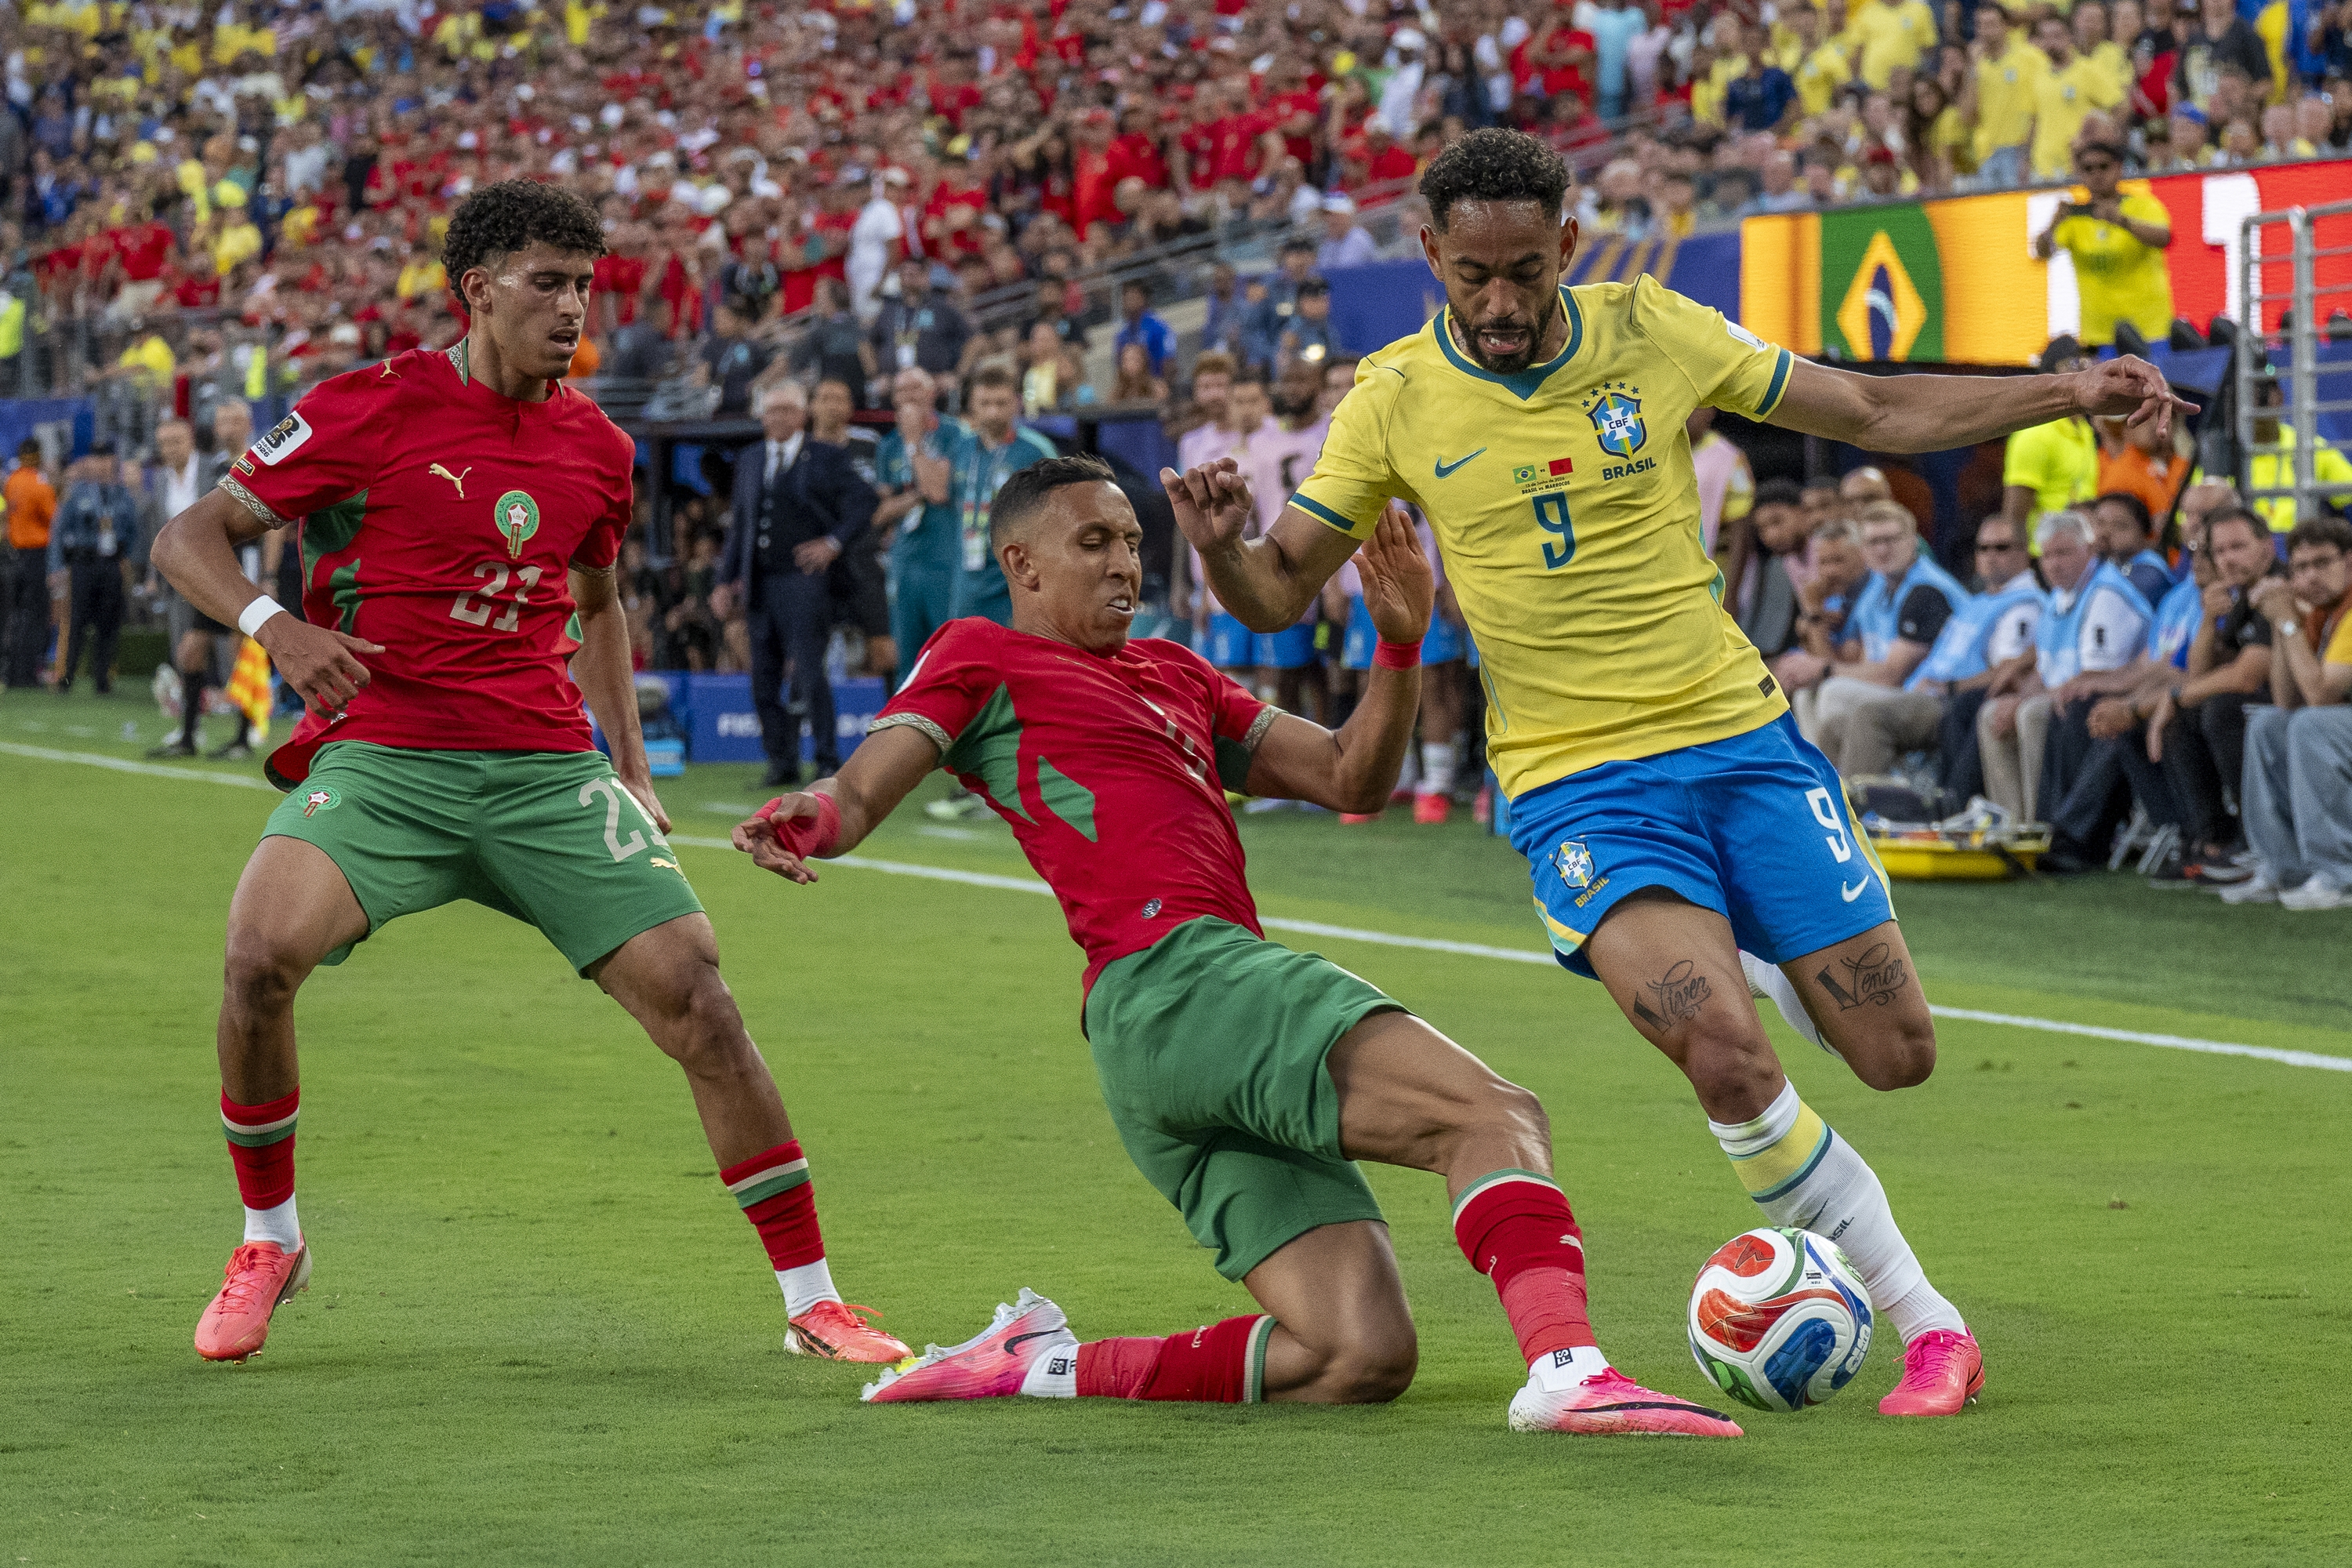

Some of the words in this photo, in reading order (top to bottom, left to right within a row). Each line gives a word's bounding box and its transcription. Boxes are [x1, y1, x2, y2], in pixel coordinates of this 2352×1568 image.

[1609, 417, 1628, 430] CBF
[256, 441, 270, 457] 026
[1602, 457, 1657, 481] BRASIL
[1544, 481, 1570, 489] MARROCOS
[1531, 491, 1577, 571] 9
[449, 561, 543, 632] 21
[1805, 786, 1851, 863] 9
[1567, 858, 1581, 871] CBF
[1574, 877, 1610, 908] BRASIL
